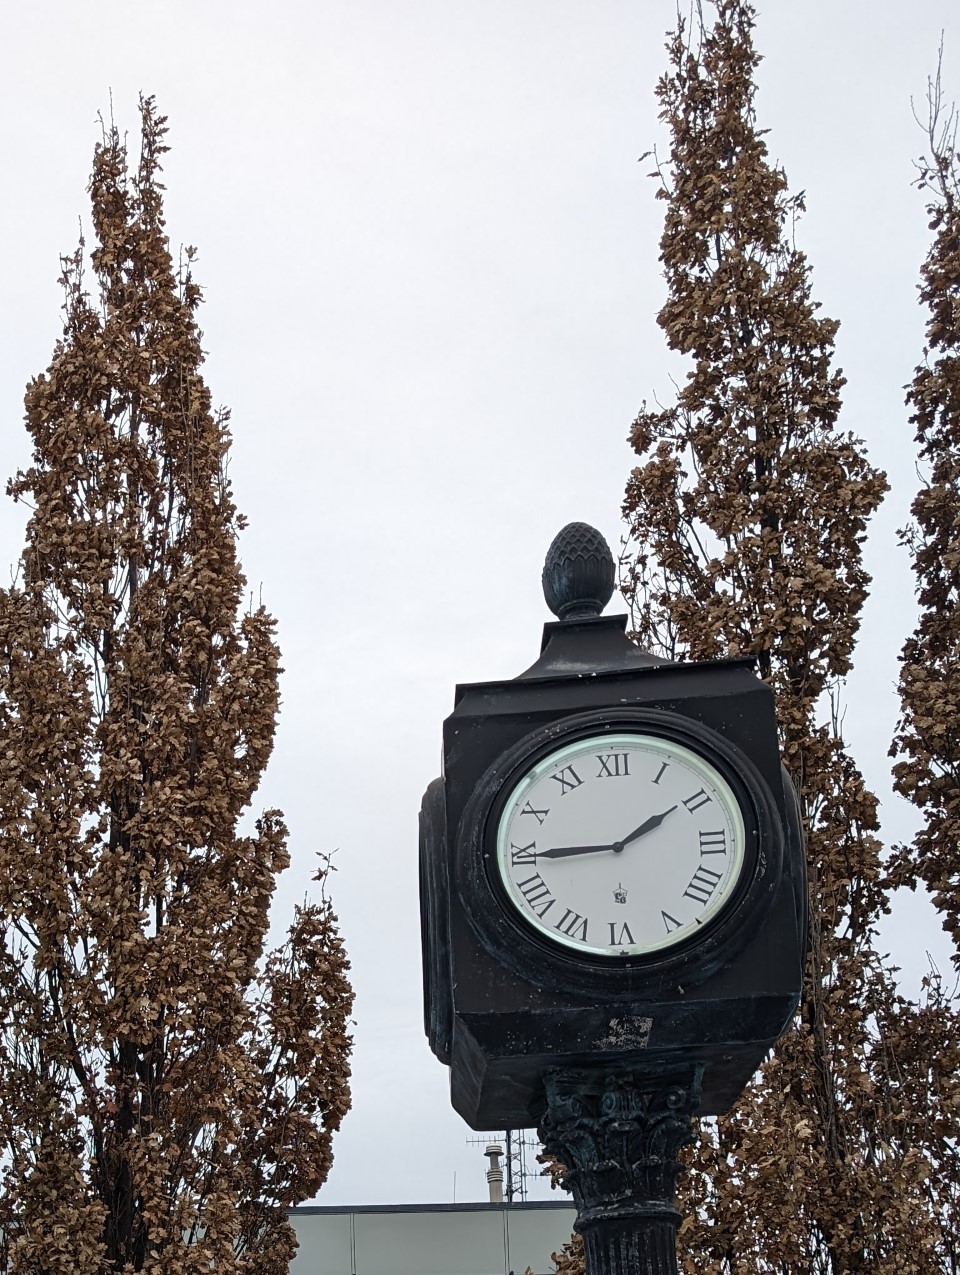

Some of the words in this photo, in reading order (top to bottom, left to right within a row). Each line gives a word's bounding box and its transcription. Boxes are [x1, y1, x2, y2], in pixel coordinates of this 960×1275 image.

[595, 753, 631, 778] XII
[651, 761, 670, 785] I
[549, 764, 585, 796] XI
[520, 800, 550, 825] X
[681, 788, 713, 814] II
[511, 840, 537, 867] IX
[699, 829, 726, 857] III
[516, 872, 557, 919] VIII
[682, 864, 723, 906] IIII
[553, 908, 589, 943] VII
[607, 922, 637, 946] VI
[661, 910, 684, 934] V
